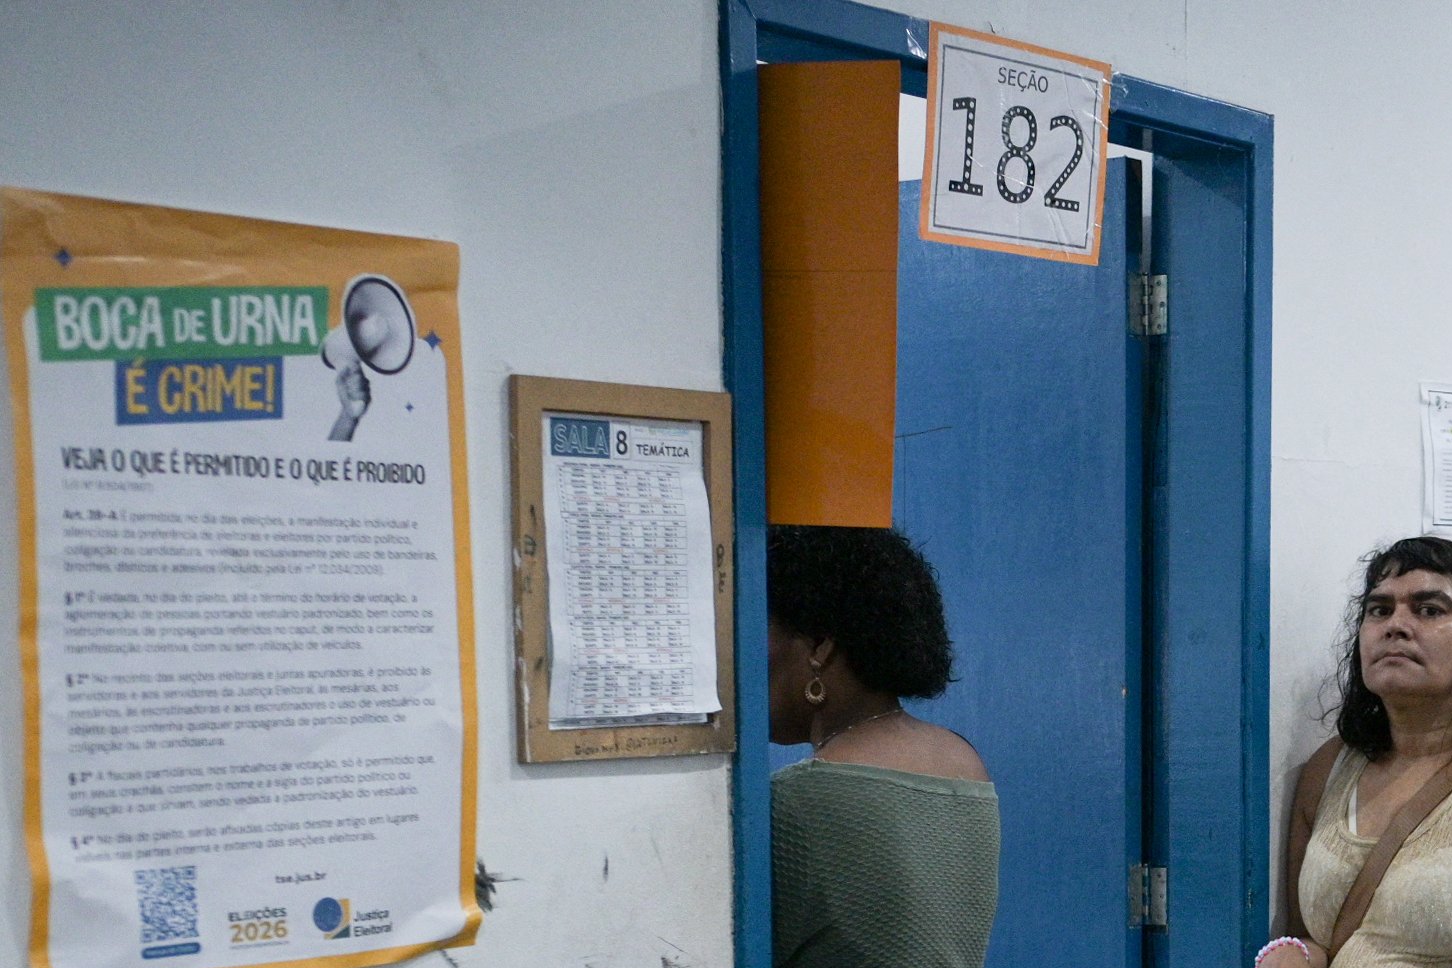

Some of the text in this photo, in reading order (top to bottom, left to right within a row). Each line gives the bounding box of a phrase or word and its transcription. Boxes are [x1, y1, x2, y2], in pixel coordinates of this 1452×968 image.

[997, 66, 1049, 93] SEÇÃO
[949, 96, 1084, 212] 182
[54, 294, 319, 350] BOCA DE URNA
[125, 355, 276, 415] É CRIME!
[553, 423, 628, 455] SALA 8
[636, 442, 689, 457] TEMÁTICA
[61, 446, 426, 486] VEJA O QUE É PERMITIDO E O QUE É PROIBIDO
[275, 872, 326, 884] tse.jus.br
[228, 906, 287, 922] ELEIÇÕES
[353, 909, 389, 923] Justiça
[230, 920, 288, 943] 2026
[353, 922, 393, 938] Eleitoral
